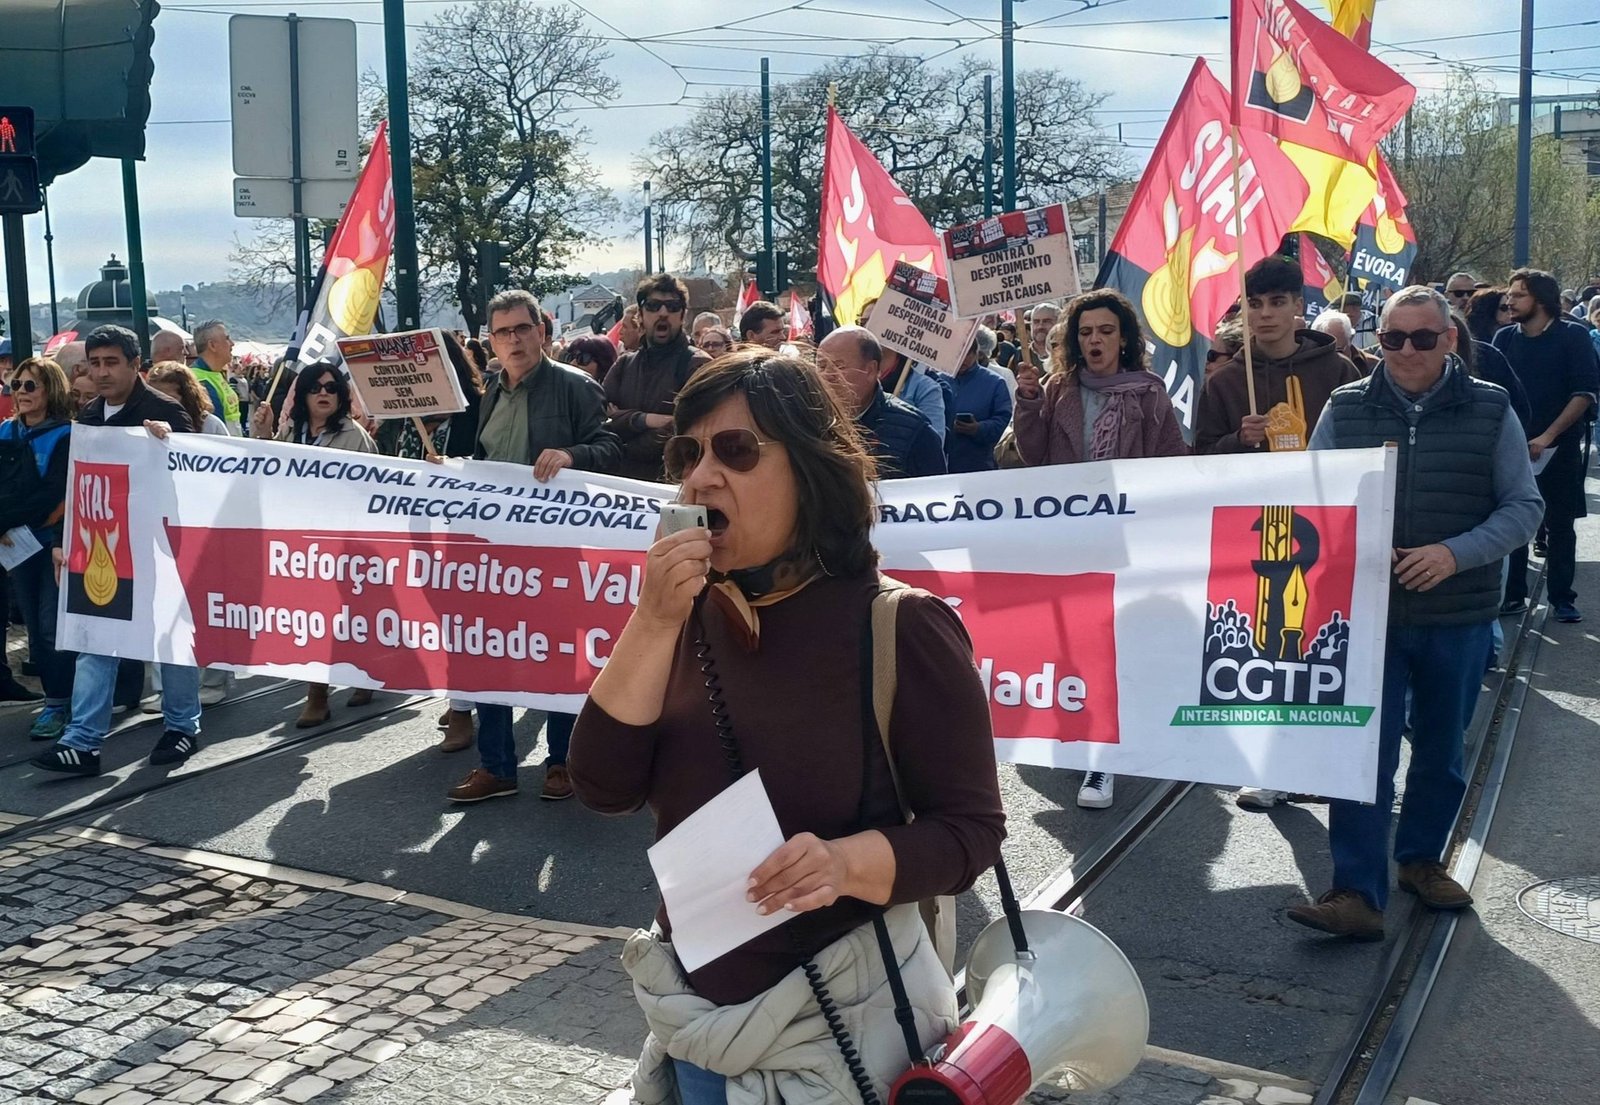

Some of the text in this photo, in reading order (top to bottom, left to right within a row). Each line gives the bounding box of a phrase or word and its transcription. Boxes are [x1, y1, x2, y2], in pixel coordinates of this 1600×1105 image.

[1180, 119, 1264, 237] STAL
[970, 254, 1051, 282] DESPEDIMENTO
[982, 244, 1035, 265] CONTRA O
[1352, 248, 1405, 286] ÉVORA
[980, 282, 1052, 307] JUSTA CAUSA
[1001, 274, 1024, 288] SEM
[888, 304, 952, 339] DESPEDIMENTO
[903, 297, 937, 318] CONTRA
[939, 312, 946, 323] O
[881, 328, 938, 361] JUSTA CAUSA
[905, 325, 924, 341] SEM
[368, 372, 433, 387] DESPEDIMENTO
[373, 362, 417, 376] CONTRA O
[383, 396, 439, 409] JUSTA CAUSA
[394, 387, 414, 397] SEM
[79, 474, 114, 522] STAL
[168, 451, 281, 476] SINDICATO
[286, 458, 418, 488] NACIONAL
[878, 494, 1004, 524] RAÇÃO
[1014, 493, 1136, 519] LOCAL
[368, 494, 648, 530] DIRECÇÃO REGIONAL
[269, 540, 400, 595] Reforçar
[406, 549, 543, 598] Direitos
[578, 561, 641, 606] Val
[207, 592, 326, 647] Emprego
[332, 605, 368, 643] de
[376, 608, 549, 662] Qualidade
[1206, 657, 1343, 704] CGTP
[1181, 709, 1360, 723] INTERSINDICAL NACIONAL
